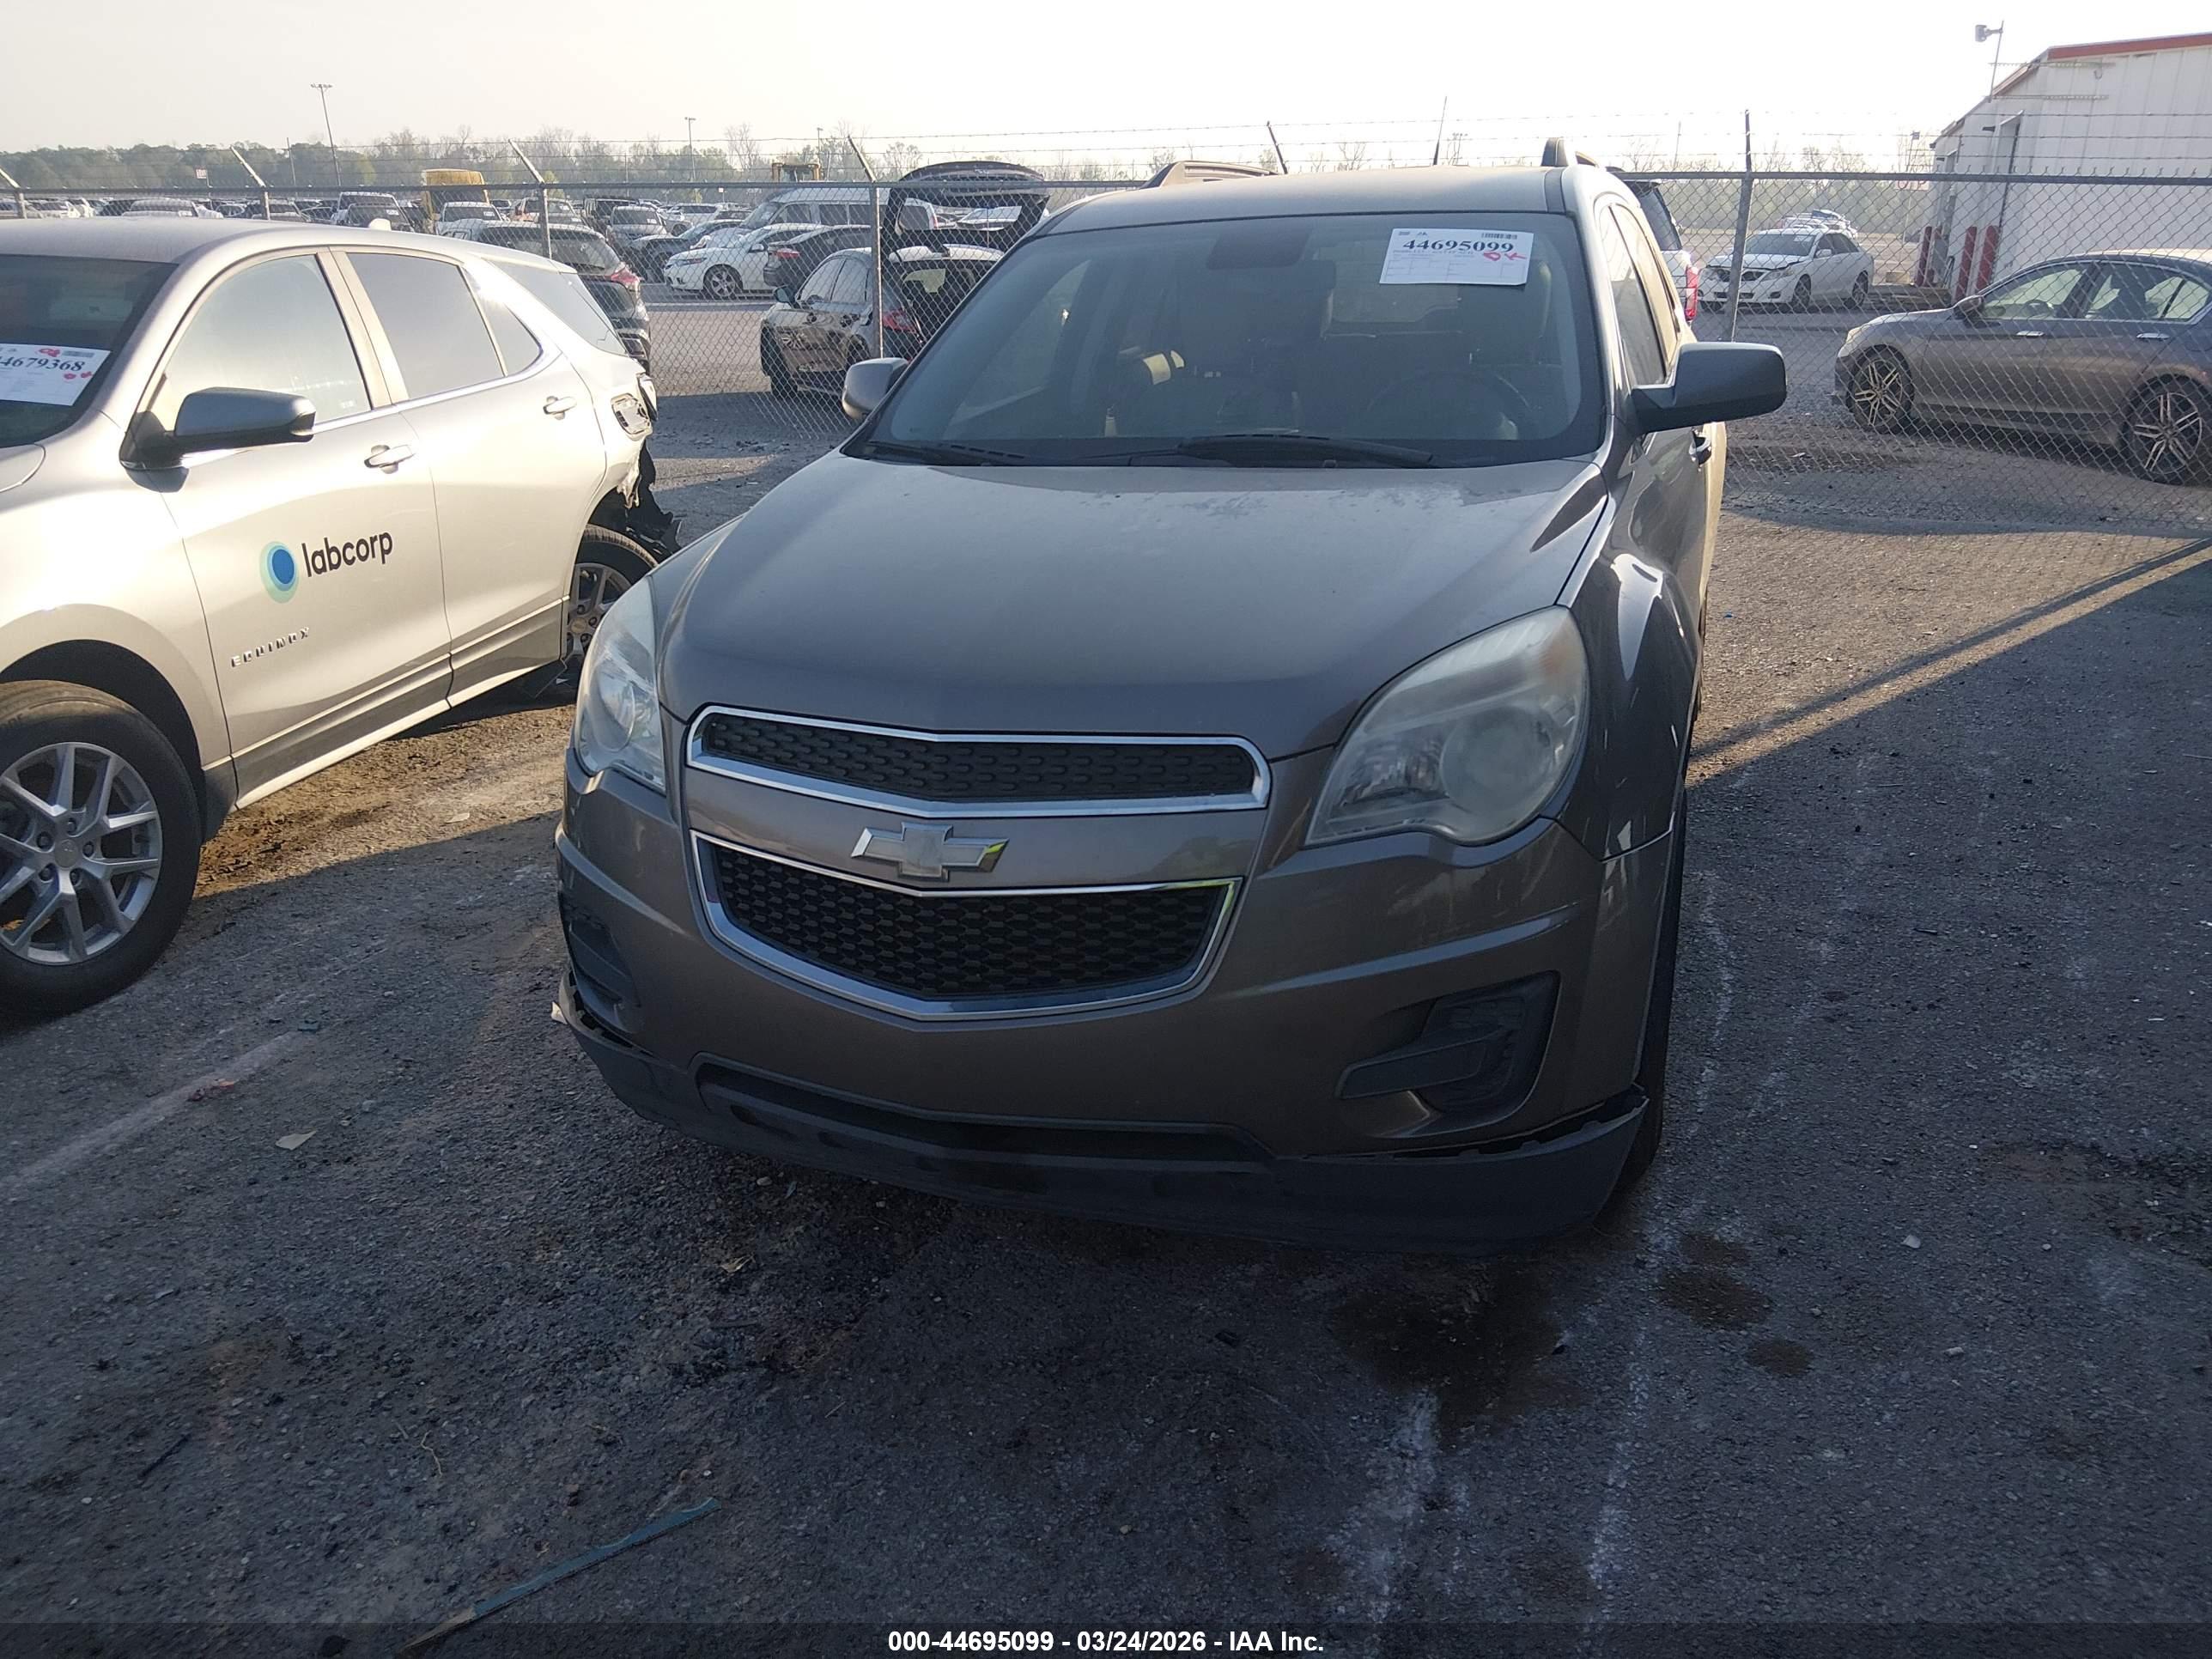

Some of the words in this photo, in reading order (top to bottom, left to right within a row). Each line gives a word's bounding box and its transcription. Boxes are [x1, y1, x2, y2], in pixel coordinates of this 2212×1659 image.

[1402, 239, 1514, 252] 44695099
[0, 355, 86, 372] 4679368
[301, 532, 393, 578] labcorp
[231, 627, 309, 667] EQUINOX
